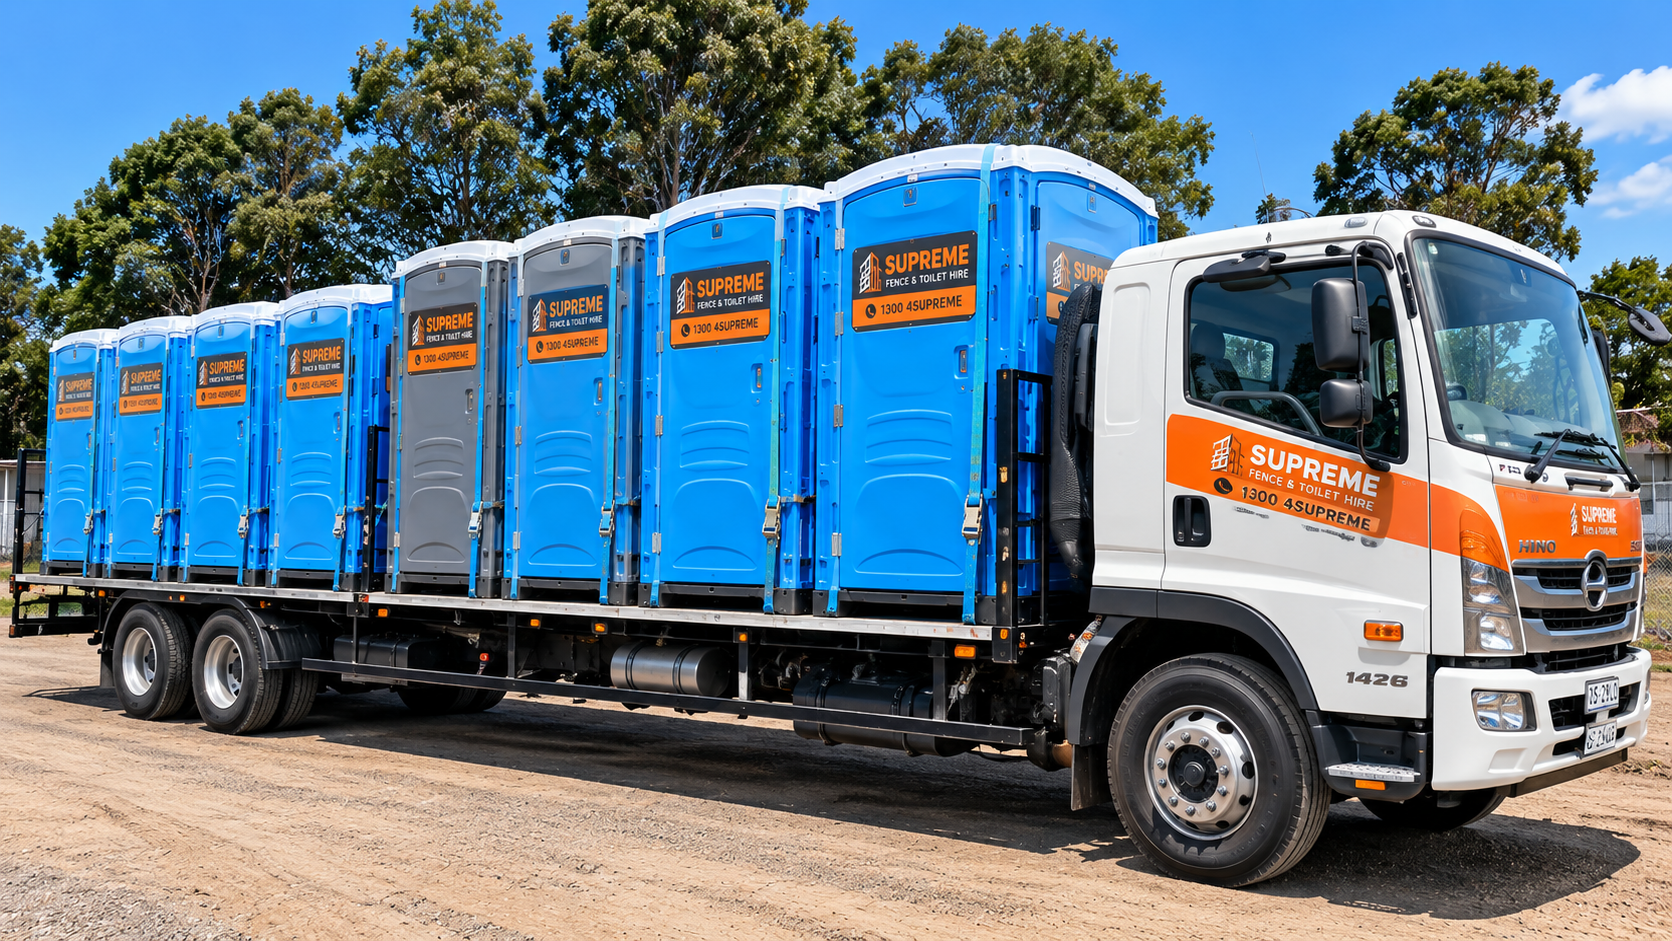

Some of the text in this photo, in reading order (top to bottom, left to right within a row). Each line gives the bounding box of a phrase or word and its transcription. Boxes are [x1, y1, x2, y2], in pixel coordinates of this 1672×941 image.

[885, 244, 970, 276] SUPREME
[697, 272, 764, 298] SUPREME
[885, 269, 969, 288] FENCE & TOILET HIRE
[549, 295, 604, 318] SUPREME
[697, 300, 716, 310] FENCE
[724, 296, 746, 307] TOILET
[880, 295, 962, 315] 1300 4SUPREME
[426, 311, 473, 332] SUPREME
[693, 317, 759, 334] 1300 4SUPREME
[302, 345, 341, 364] SUPREME
[209, 359, 245, 375] SUPREME
[1250, 444, 1381, 498] SUPREME
[1249, 468, 1375, 512] FENCE & TOILET HIRE
[1241, 486, 1278, 506] 1300
[1283, 497, 1371, 532] 4SUPREME
[1581, 505, 1617, 524] SUPREME
[1518, 539, 1556, 554] HINO
[1346, 671, 1409, 688] 1426
